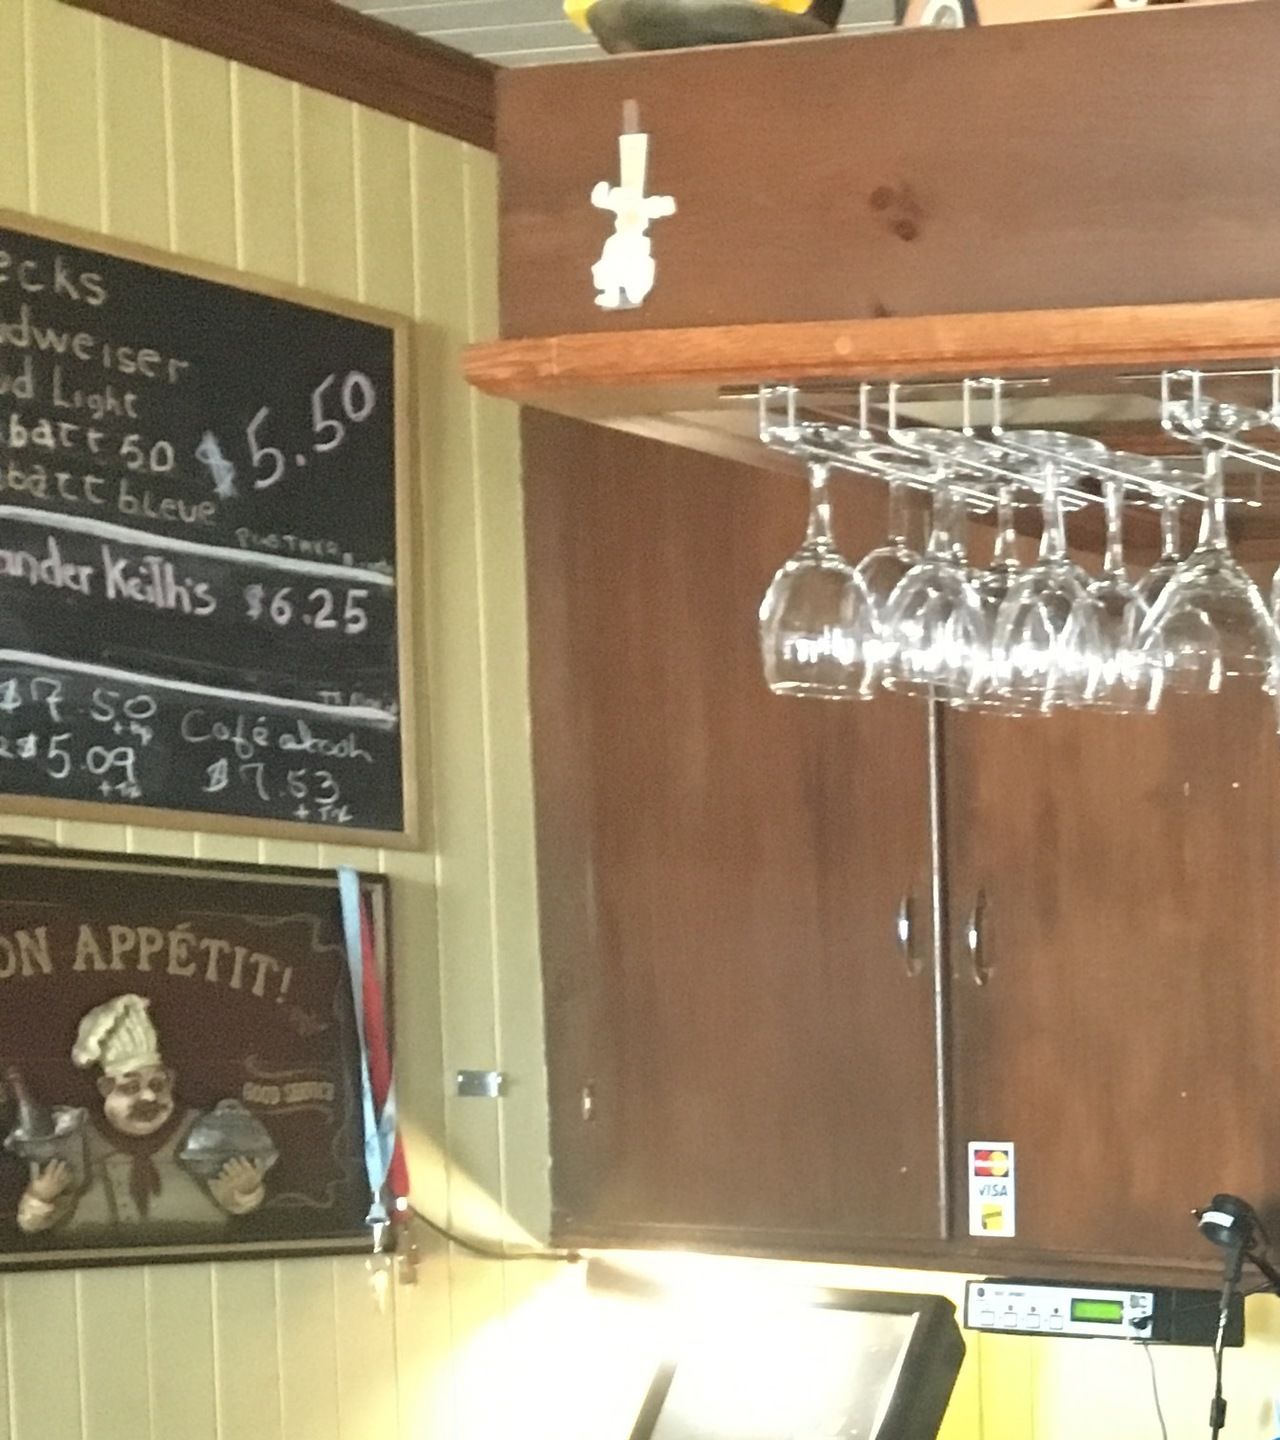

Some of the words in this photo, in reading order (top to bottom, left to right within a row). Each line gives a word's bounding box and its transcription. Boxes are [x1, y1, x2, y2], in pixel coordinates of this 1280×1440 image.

[119, 433, 175, 472] 50
[245, 585, 371, 634] $6.25
[72, 921, 294, 1003] APPÉTIT!
[978, 1184, 1008, 1197] VISA
